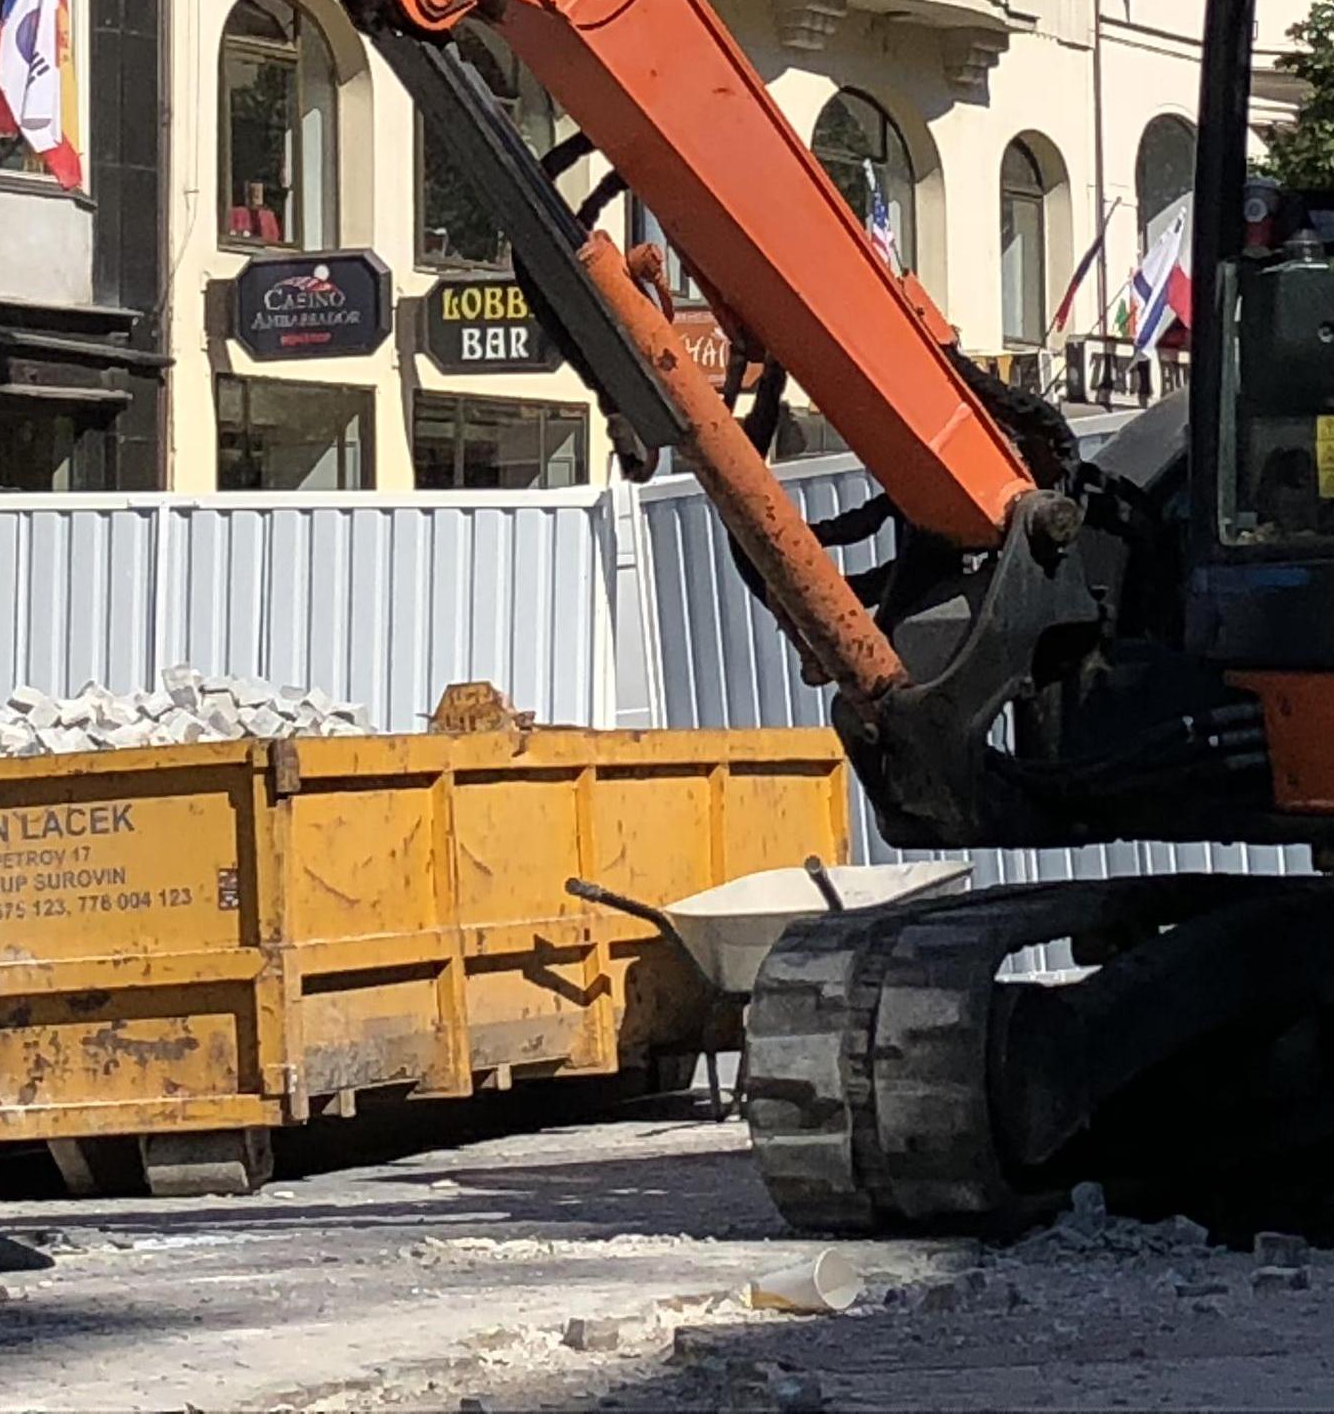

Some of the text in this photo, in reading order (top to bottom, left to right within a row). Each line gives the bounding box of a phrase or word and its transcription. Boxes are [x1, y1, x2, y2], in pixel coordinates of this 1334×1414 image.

[265, 288, 345, 311] CASINO
[442, 287, 533, 321] LOBB
[461, 327, 529, 360] BAR
[685, 336, 726, 368] HAI
[73, 847, 91, 862] 17
[34, 868, 125, 891] SUROVIN
[118, 891, 151, 910] 004
[159, 888, 192, 907] 123
